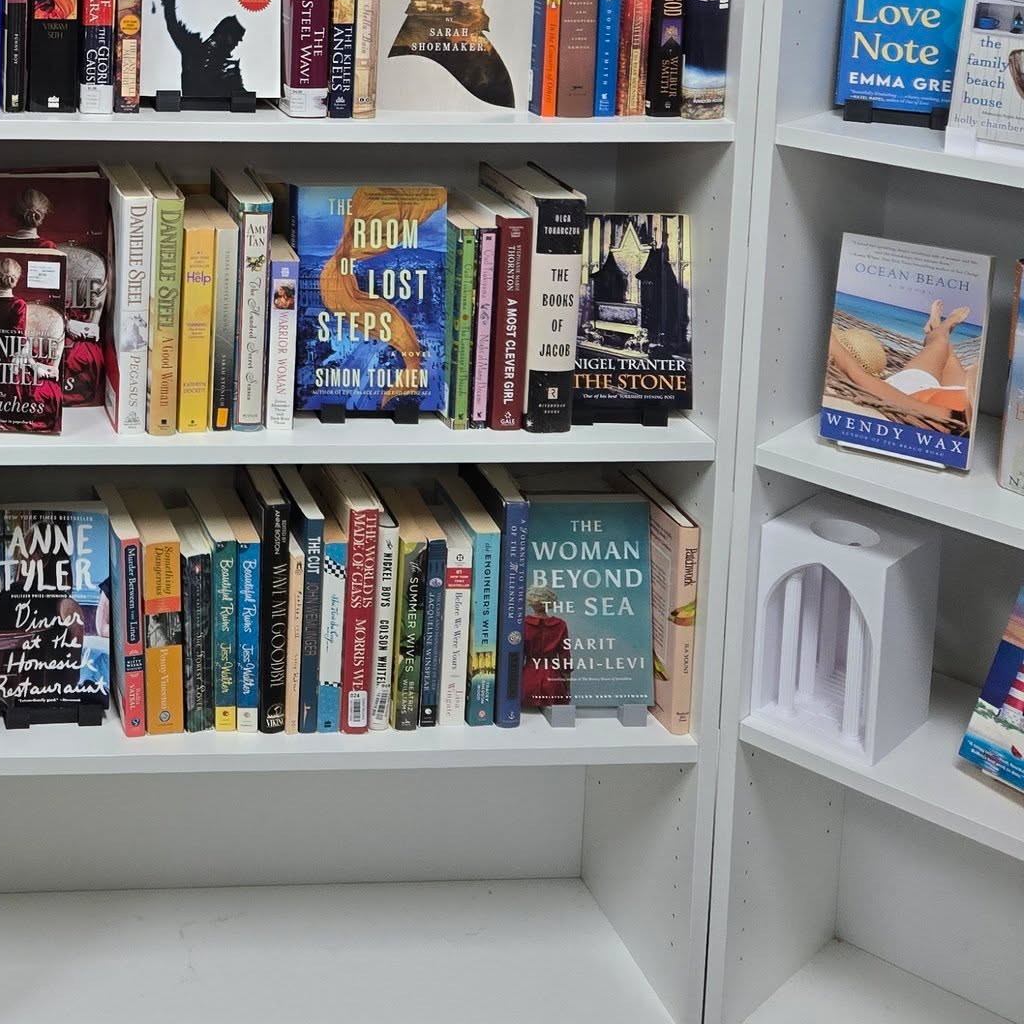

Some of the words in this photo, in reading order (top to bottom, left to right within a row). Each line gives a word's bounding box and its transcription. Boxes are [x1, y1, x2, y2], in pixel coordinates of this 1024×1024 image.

[430, 28, 472, 36] SARAH.
[411, 42, 487, 51] SHOEMAKER.
[852, 31, 939, 65] Note
[981, 36, 1001, 49] the
[967, 53, 1009, 72] family
[849, 72, 905, 89] EMMA
[913, 76, 952, 92] GRE
[966, 72, 1005, 89] beach
[963, 92, 1002, 108] house
[329, 198, 353, 216] THE
[247, 224, 266, 234] AMY
[354, 219, 418, 249] ROOM
[247, 235, 265, 247] TAN
[341, 258, 357, 275] OF
[552, 269, 569, 282] THE
[855, 262, 911, 281] OCEAN
[916, 273, 970, 292] BEACH
[369, 269, 427, 300] LOST
[542, 294, 574, 307] BOOKS
[318, 312, 392, 342] STEPS
[552, 319, 563, 332] OF
[539, 343, 571, 357] JACOB
[575, 358, 616, 370] NIGEL
[618, 358, 686, 371] TRANTER
[315, 369, 361, 388] SIMON
[369, 369, 428, 388] TOLKIEN
[574, 374, 612, 389] THE
[618, 374, 686, 391] STONE
[826, 412, 904, 440] WENDY
[916, 432, 963, 454] WAX
[570, 520, 603, 532] THE
[8, 524, 93, 555] ANNE
[531, 541, 640, 561] WOMAN
[532, 569, 643, 589] BEYOND
[542, 602, 574, 613] THE
[584, 597, 634, 616] SEA
[15, 600, 84, 632] Dinner
[22, 637, 41, 650] at
[52, 629, 81, 648] the
[563, 638, 616, 650] SARIT
[4, 655, 97, 674] Homesick
[532, 657, 645, 670] YISHAI-LEVI
